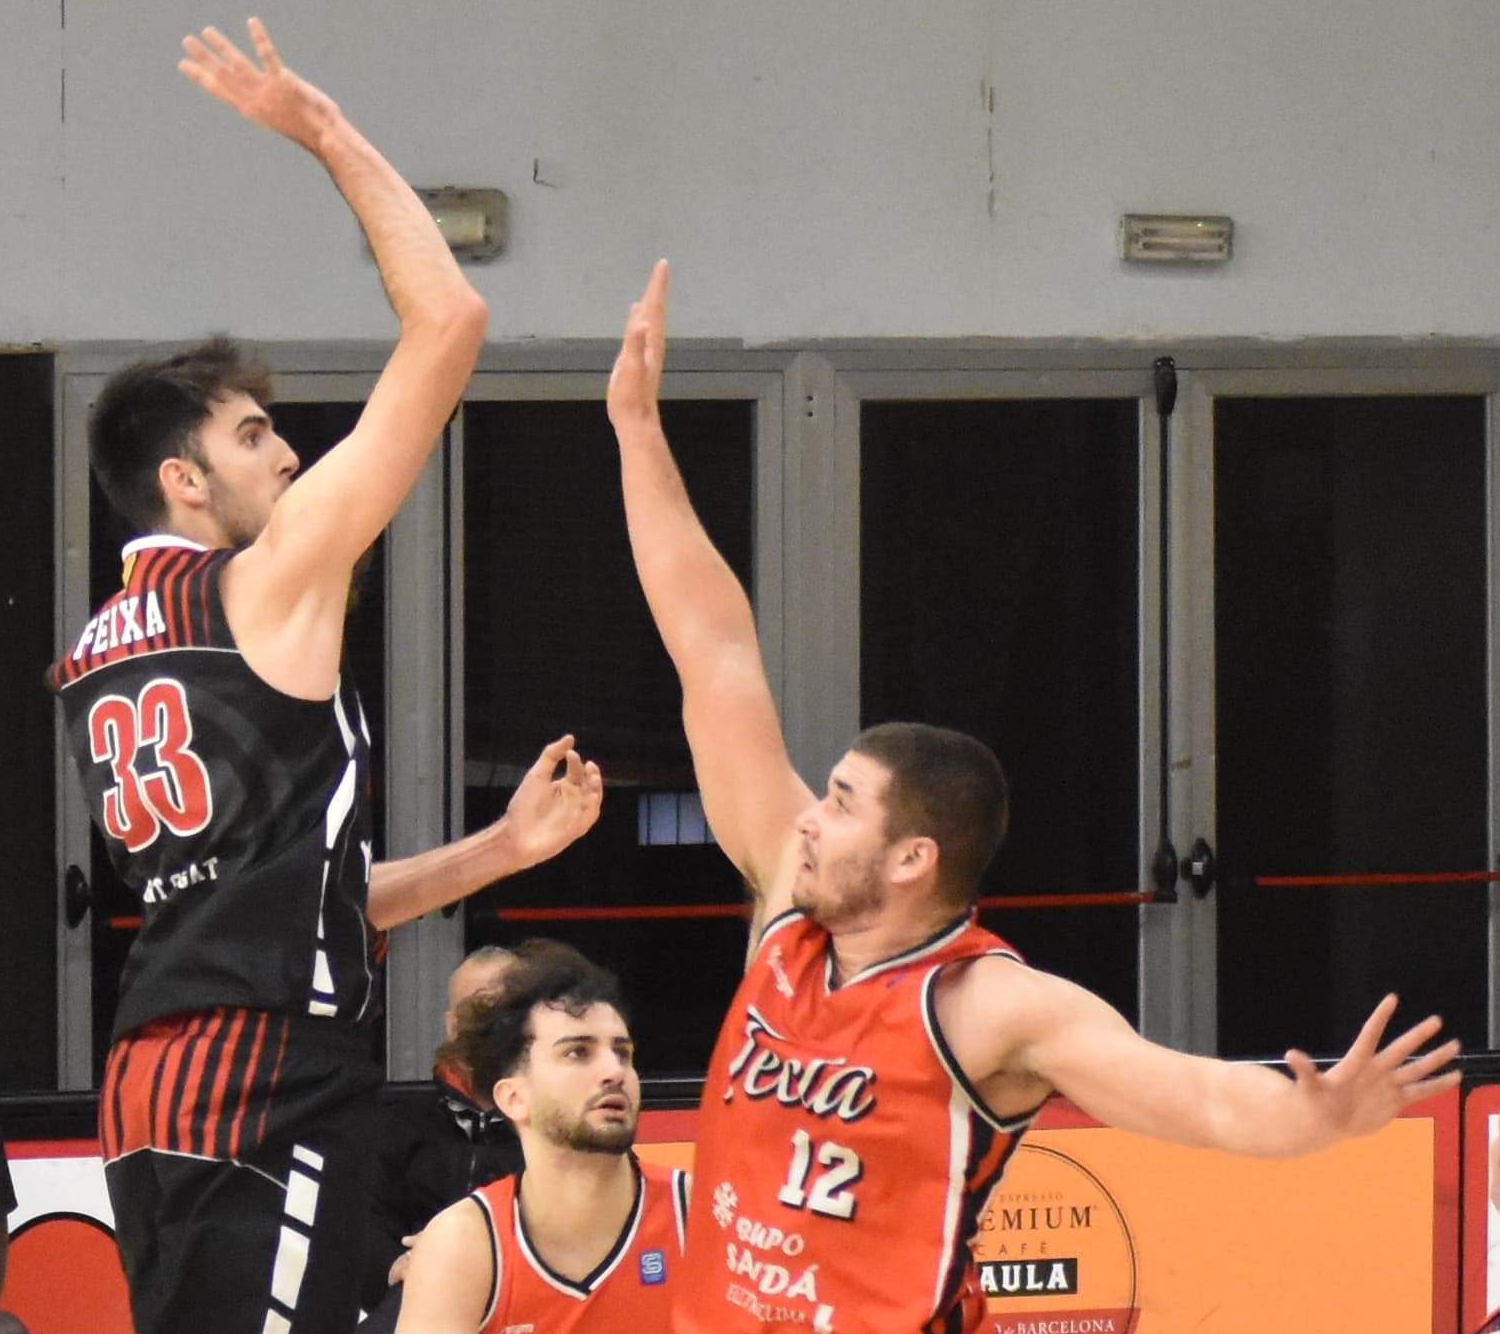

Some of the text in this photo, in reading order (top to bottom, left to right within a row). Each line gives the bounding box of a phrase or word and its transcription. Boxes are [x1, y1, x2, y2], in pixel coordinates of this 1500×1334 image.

[73, 590, 166, 661] FEIXA
[89, 678, 212, 853] 33
[777, 1128, 864, 1223] 12
[980, 1263, 1069, 1293] AULA
[1017, 1319, 1115, 1334] BARCELONA
